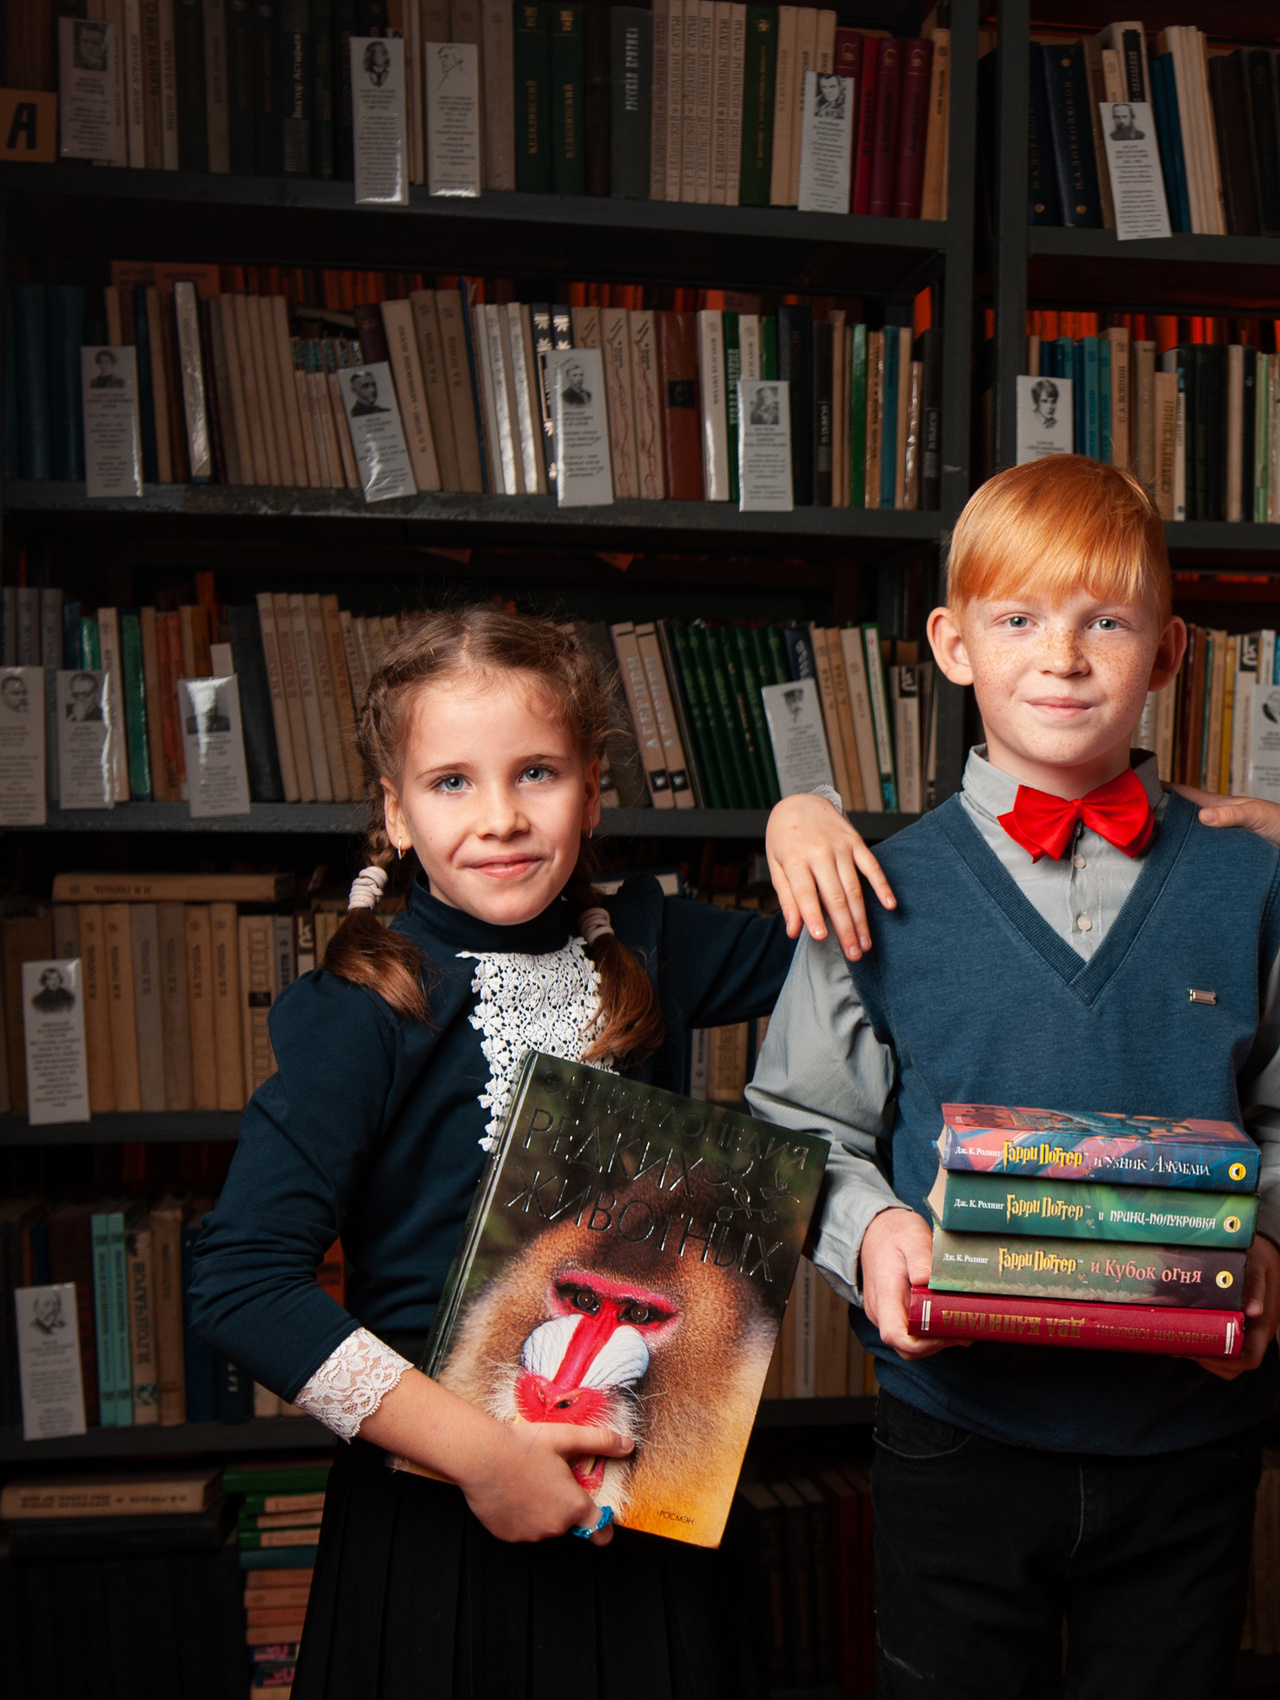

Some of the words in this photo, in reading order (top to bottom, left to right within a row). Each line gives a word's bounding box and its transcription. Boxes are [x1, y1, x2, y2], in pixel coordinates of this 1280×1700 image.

[7, 102, 37, 150] А
[541, 1070, 809, 1171] ЭНЦИКЛОПЕДИЯ
[523, 1108, 704, 1198] РЕДКИХ
[976, 1148, 1002, 1157] Ролинг
[1003, 1141, 1038, 1171] Гарри
[1039, 1143, 1083, 1168] Поттер
[1094, 1156, 1102, 1167] и
[504, 1165, 784, 1282] ЖИВОТНЫХ
[954, 1199, 968, 1207] Дж.
[978, 1200, 1005, 1210] Ролинг
[1006, 1194, 1040, 1224] Гарри
[1041, 1196, 1084, 1221] Поттер
[1098, 1211, 1104, 1220] и
[964, 1255, 989, 1264] Ролинг
[999, 1248, 1033, 1277] Гарри
[1034, 1250, 1078, 1275] Поттер
[1090, 1261, 1100, 1273] и
[1104, 1259, 1157, 1283] Кубок
[1161, 1267, 1202, 1284] огня
[941, 1310, 1042, 1336] КАПИТАНА
[1045, 1316, 1086, 1338] ДВА
